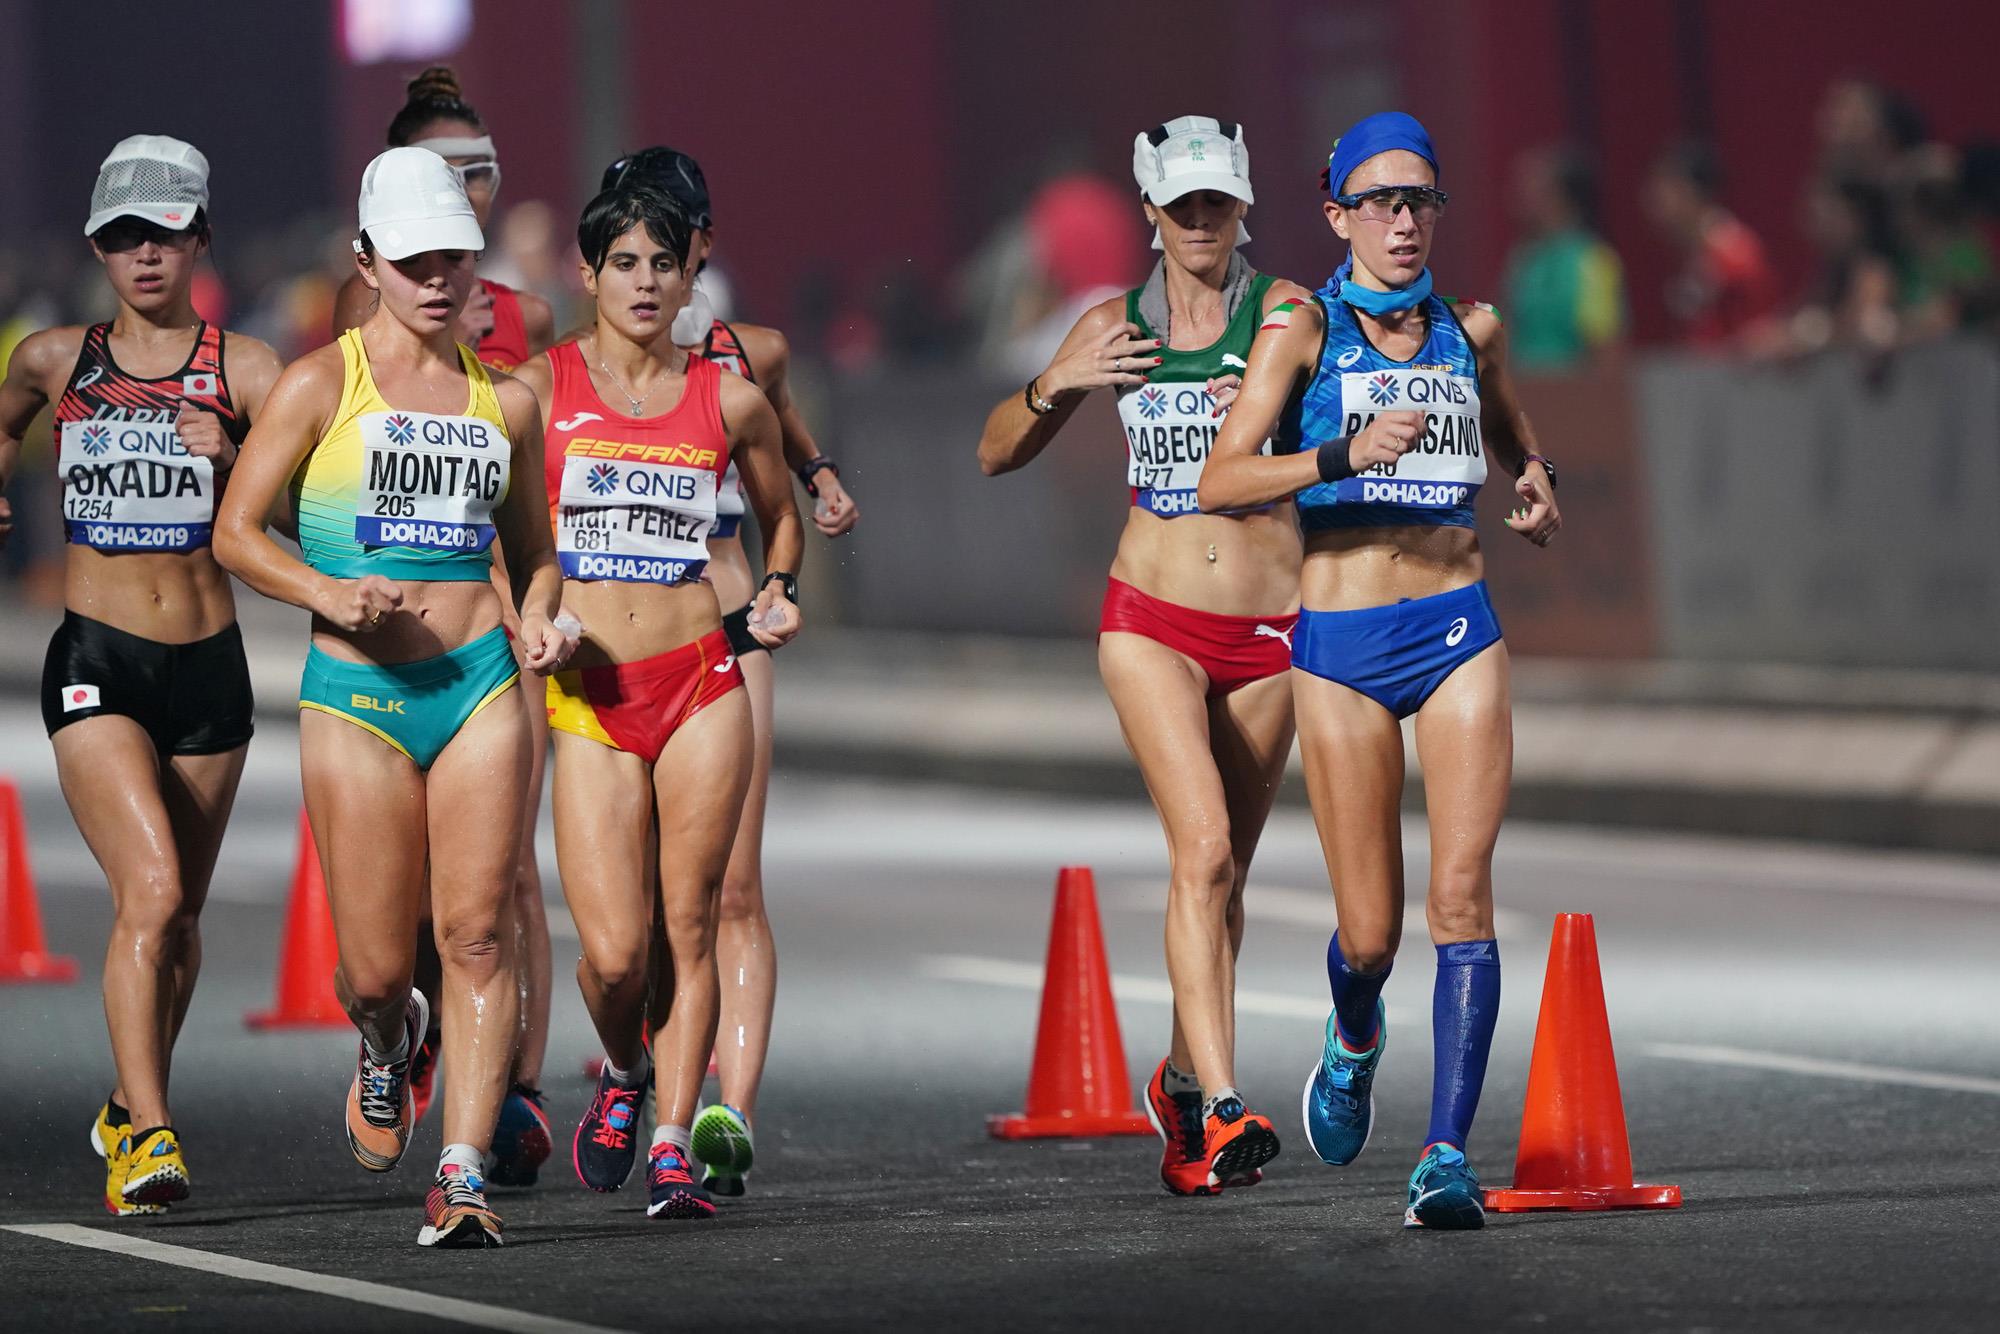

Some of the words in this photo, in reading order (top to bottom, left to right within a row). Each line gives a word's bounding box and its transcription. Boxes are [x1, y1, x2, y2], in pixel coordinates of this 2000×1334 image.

[1175, 390, 1229, 415] QN
[1407, 377, 1467, 404] QNB
[81, 404, 182, 424] JAPA
[119, 430, 188, 456] QNB
[422, 420, 489, 449] QNB
[563, 438, 718, 467] ESPAÑA
[68, 461, 202, 498] OKADA
[369, 450, 501, 501] MONTAG
[1361, 462, 1397, 477] 40
[626, 470, 696, 500] QNB
[68, 498, 113, 520] 1254
[374, 495, 416, 517] 205
[85, 525, 189, 546] DOHA2019
[380, 522, 479, 548] DOHA2019
[627, 504, 707, 543] PEREZ
[574, 530, 611, 551] 681
[578, 556, 687, 581] DOHA2019
[352, 694, 406, 715] BLK
